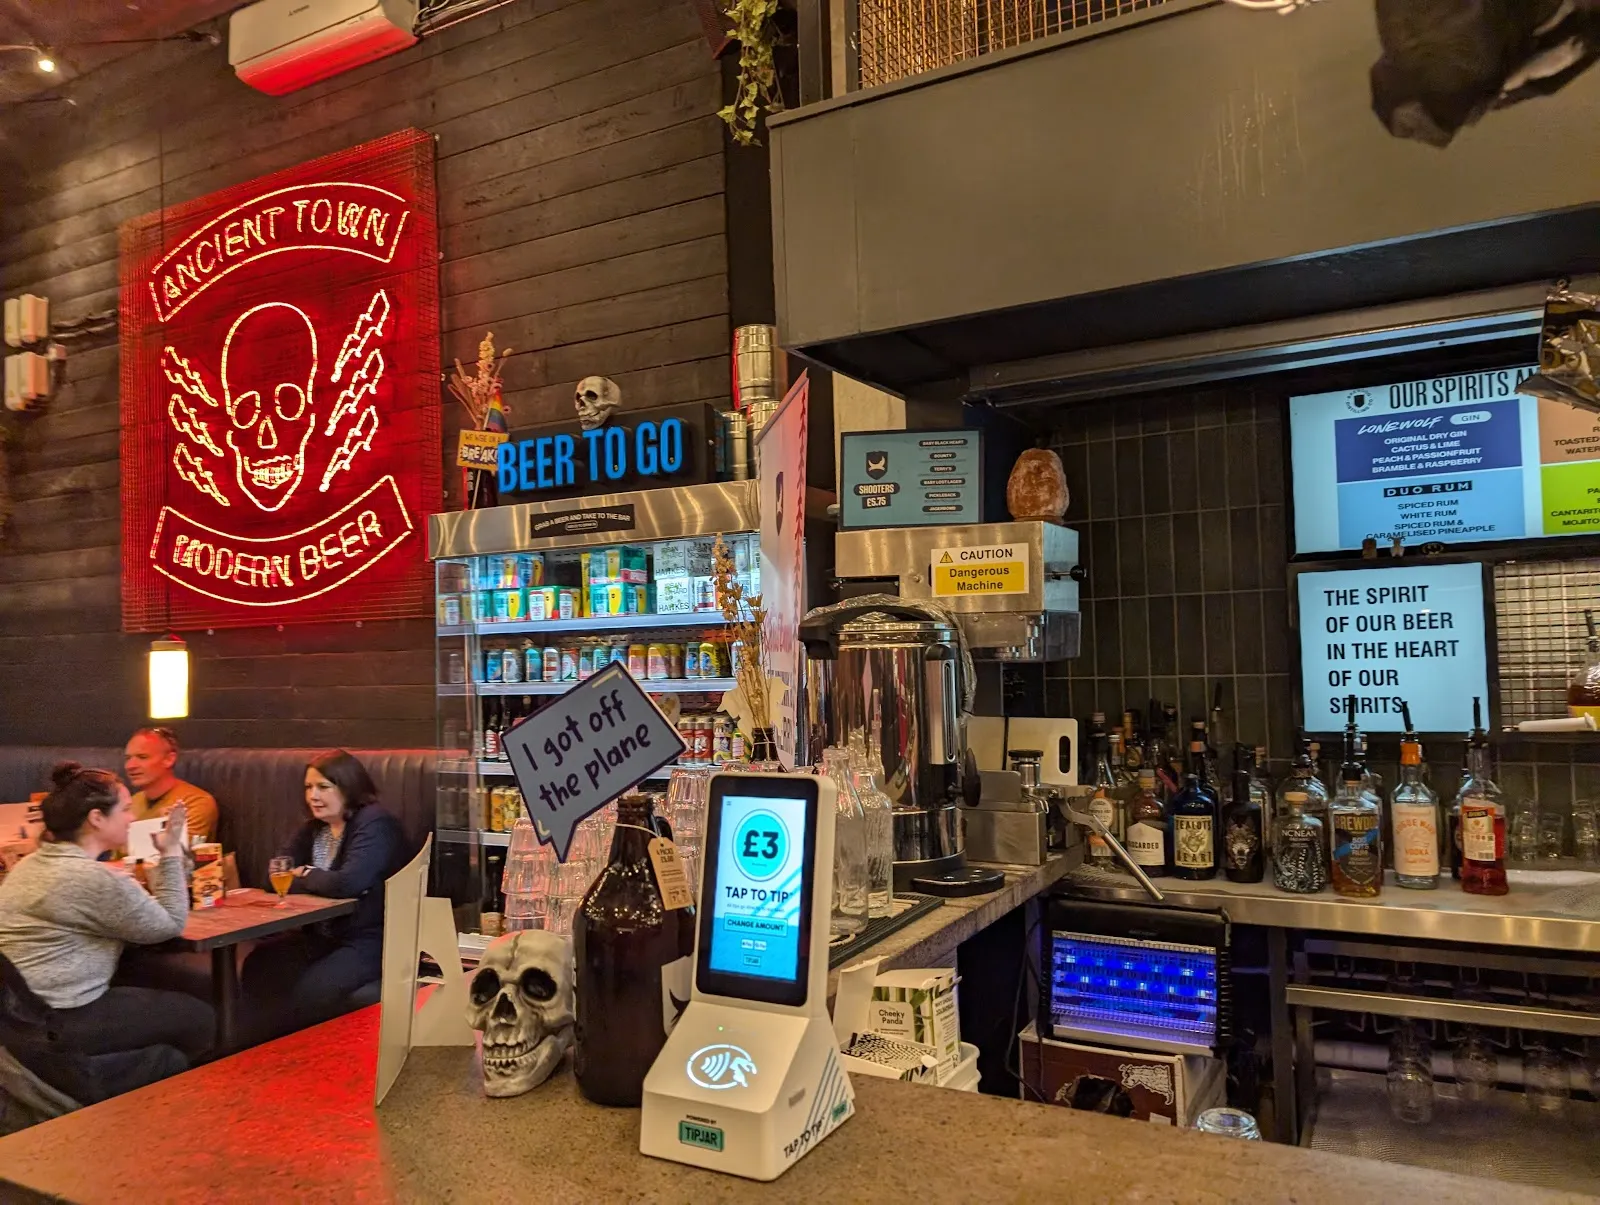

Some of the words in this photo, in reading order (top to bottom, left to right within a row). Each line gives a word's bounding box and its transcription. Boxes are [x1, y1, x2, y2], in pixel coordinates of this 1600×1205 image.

[162, 207, 285, 306] ANCIENT
[293, 199, 390, 247] TOWN
[1390, 382, 1427, 409] OUR
[1432, 371, 1509, 405] SPIRITS
[1357, 416, 1444, 435] LONEWOLF
[1461, 414, 1480, 422] GIN
[1384, 434, 1427, 445] ORIGINAL
[1429, 432, 1448, 440] DRY
[1449, 430, 1467, 438] GIN
[1391, 443, 1429, 454] CACTUS
[1437, 440, 1461, 449] LIME
[498, 434, 575, 493] BEER
[583, 426, 626, 481] TO
[636, 418, 683, 476] GO
[1372, 454, 1404, 465] PEACH
[1412, 448, 1482, 460] PASSIONFRUIT
[1372, 463, 1416, 474] BRAMBLE
[1417, 462, 1424, 470] &
[1425, 456, 1483, 469] RASPBERRY
[858, 485, 894, 494] SHOOTERS
[1386, 486, 1423, 496] DUO
[1432, 482, 1469, 493] RUM
[866, 496, 887, 507] £5.75
[1398, 502, 1434, 510] SPICED
[1436, 500, 1459, 508] RUM
[1400, 512, 1432, 520] WHITE
[1434, 509, 1457, 518] RUM
[534, 520, 550, 531] GRAB
[1394, 522, 1431, 530] SPICED
[1432, 519, 1455, 528] RUM
[1366, 529, 1436, 540] CARAMELISED
[1438, 525, 1496, 535] PINEAPPLE
[173, 534, 294, 589] MODERN
[299, 510, 382, 581] BEER
[960, 548, 1013, 561] CAUTION
[655, 565, 686, 574] HAWKES
[949, 566, 1010, 579] Dangerous
[957, 580, 1004, 592] Machine
[1324, 588, 1359, 607] THE
[1366, 585, 1429, 606] SPIRIT
[658, 602, 690, 611] HAWKES
[1326, 617, 1350, 633] OF
[1356, 614, 1396, 632] OUR
[1403, 612, 1454, 631] BEER
[1327, 643, 1345, 661] IN
[1352, 642, 1388, 660] THE
[1395, 639, 1460, 658] HEART
[1328, 670, 1351, 687] OF
[1358, 669, 1399, 687] OUR
[522, 743, 538, 771] I
[544, 715, 583, 767] got
[589, 689, 627, 732] off
[540, 773, 581, 812] the
[584, 723, 651, 790] plane
[743, 829, 779, 859] £3
[725, 886, 748, 900] TAP
[750, 888, 768, 902] TO
[727, 919, 754, 928] CHANGE
[755, 922, 785, 931] AMOUNT
[879, 1009, 905, 1018] Cheeky
[882, 1017, 903, 1025] Panda
[800, 1130, 811, 1146] TO
